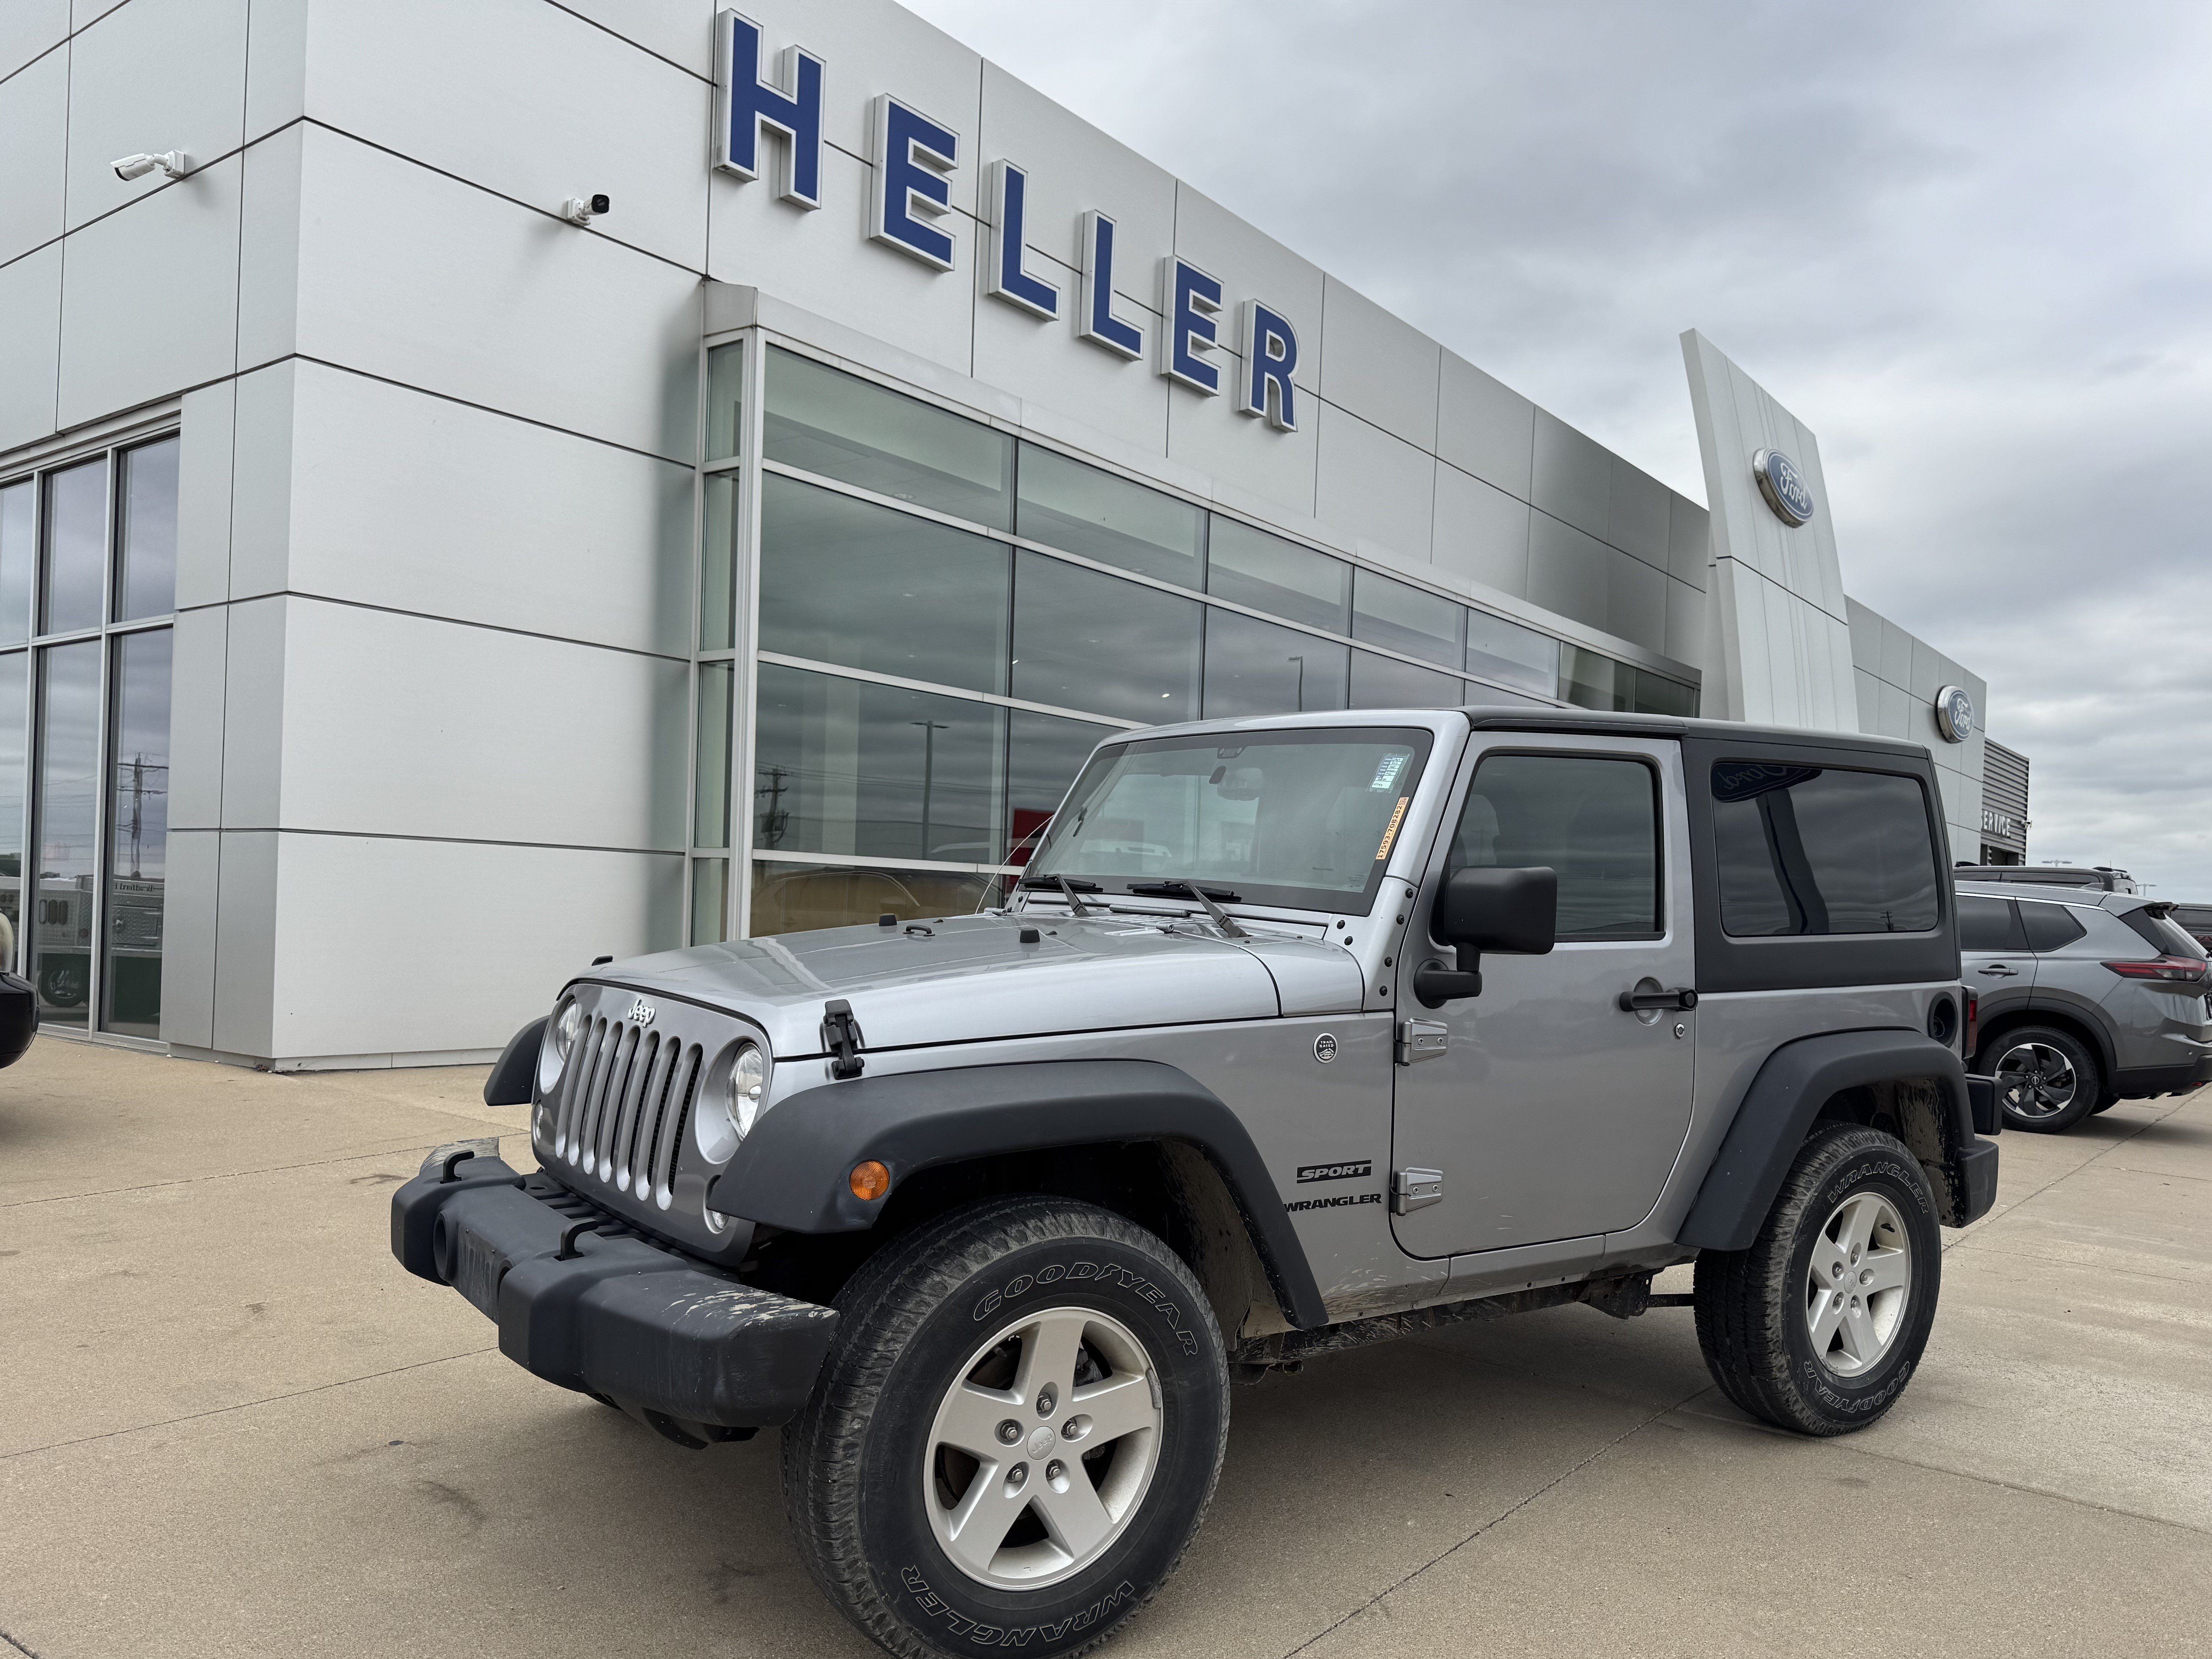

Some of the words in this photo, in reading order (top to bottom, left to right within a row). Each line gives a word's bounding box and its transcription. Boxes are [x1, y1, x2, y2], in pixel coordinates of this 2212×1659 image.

[714, 8, 1301, 434] HELLER
[1780, 462, 1807, 510] Ford
[1954, 698, 1972, 731] Ford
[1377, 805, 1403, 859] 17593-708282
[1981, 810, 2011, 837] ERVICE
[627, 999, 656, 1028] Jeep
[1301, 1163, 1371, 1180] SPORT
[1827, 1162, 1929, 1214] WRANGLER
[1284, 1193, 1382, 1212] WRANGLER
[973, 1262, 1198, 1356] GOODYEAR
[1804, 1360, 1910, 1413] GOODYEAR
[1032, 1433, 1053, 1454] Jeep
[901, 1564, 1135, 1646] WRANGLER
